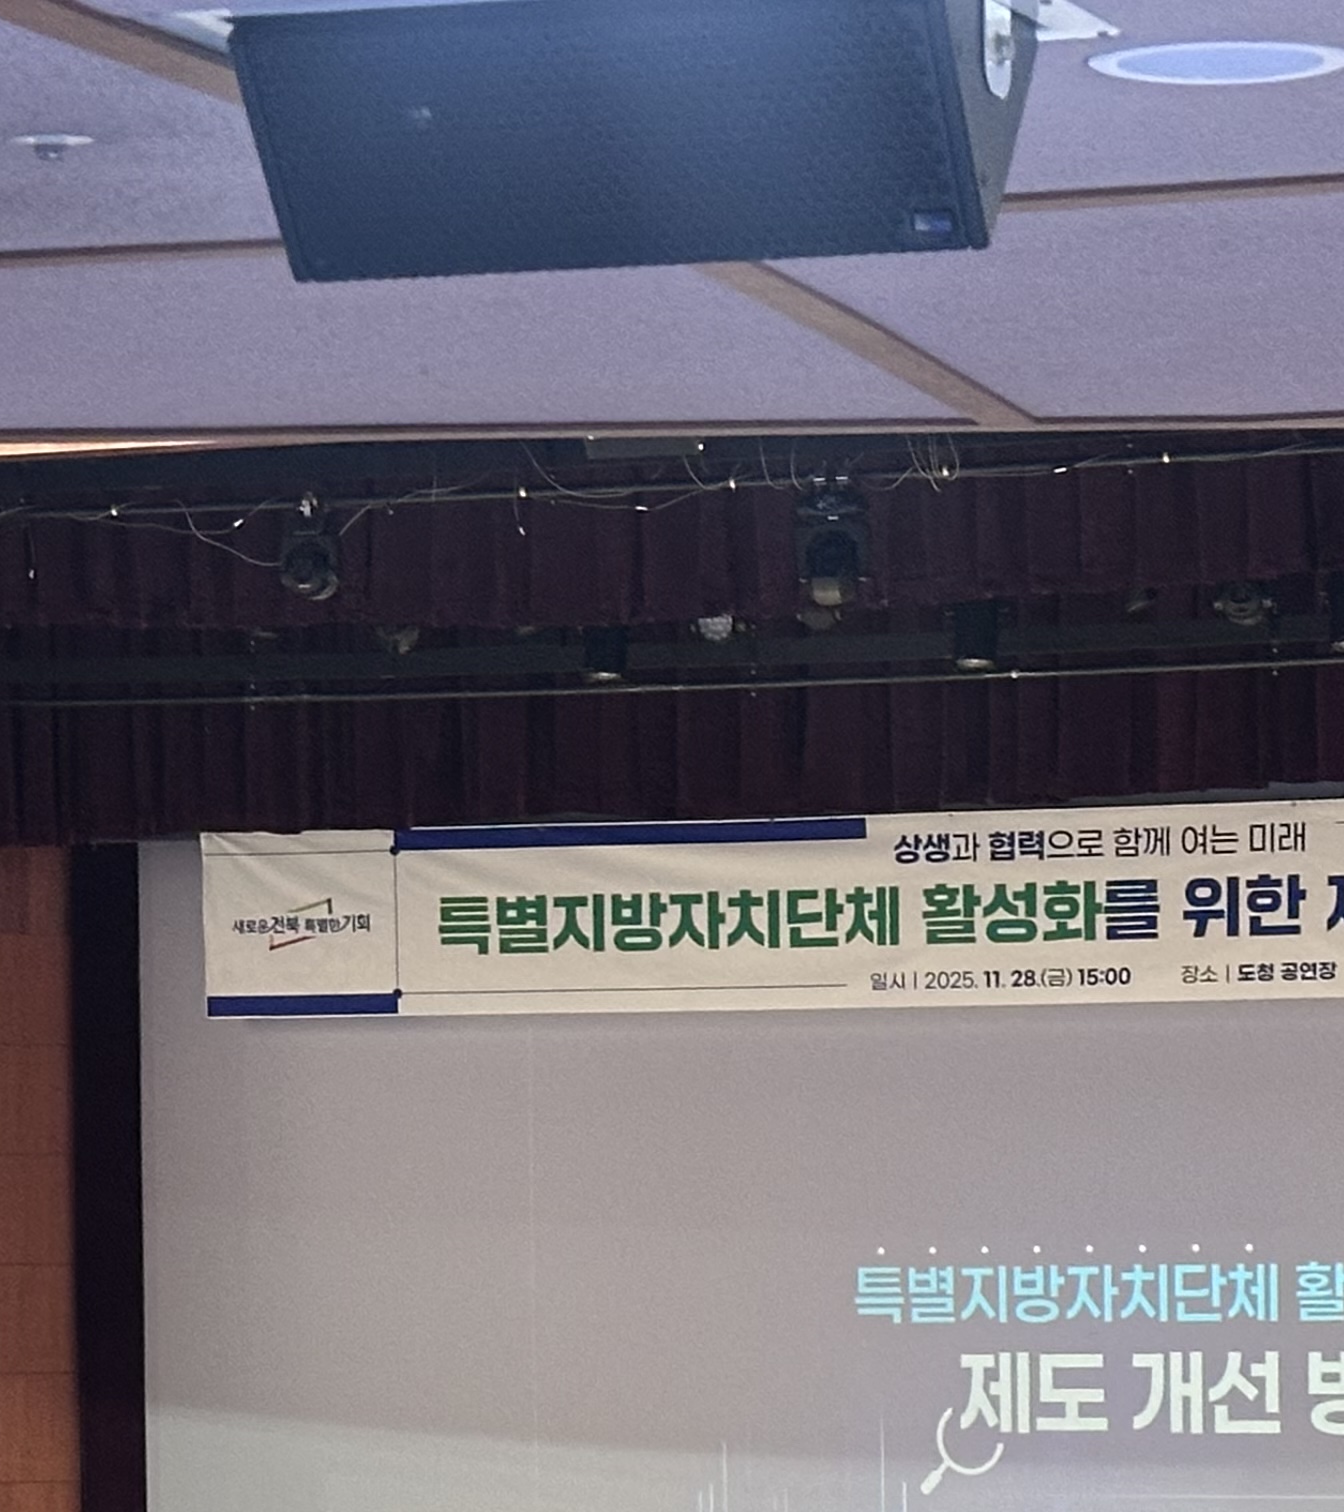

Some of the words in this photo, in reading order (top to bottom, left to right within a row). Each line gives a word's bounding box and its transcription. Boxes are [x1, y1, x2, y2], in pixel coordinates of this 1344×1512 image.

[893, 832, 981, 864] 상생과
[988, 829, 1104, 862] 협력으로
[1113, 826, 1171, 858] 함께
[1181, 824, 1239, 855] 여는
[1249, 821, 1306, 853] 미래
[438, 885, 900, 955] 특별지방자치단체
[922, 878, 1161, 945] 활성화를
[1182, 873, 1307, 938] 위한
[870, 972, 906, 991] 일시
[924, 970, 978, 990] 2025.
[1077, 966, 1132, 986] 15:00
[1181, 965, 1218, 984] 장소
[1237, 963, 1275, 982] 도청
[1281, 961, 1337, 981] 공연장
[854, 1263, 1279, 1324] 특별지방자치단체
[960, 1351, 1109, 1434] 제도
[1132, 1350, 1281, 1434] 개선
